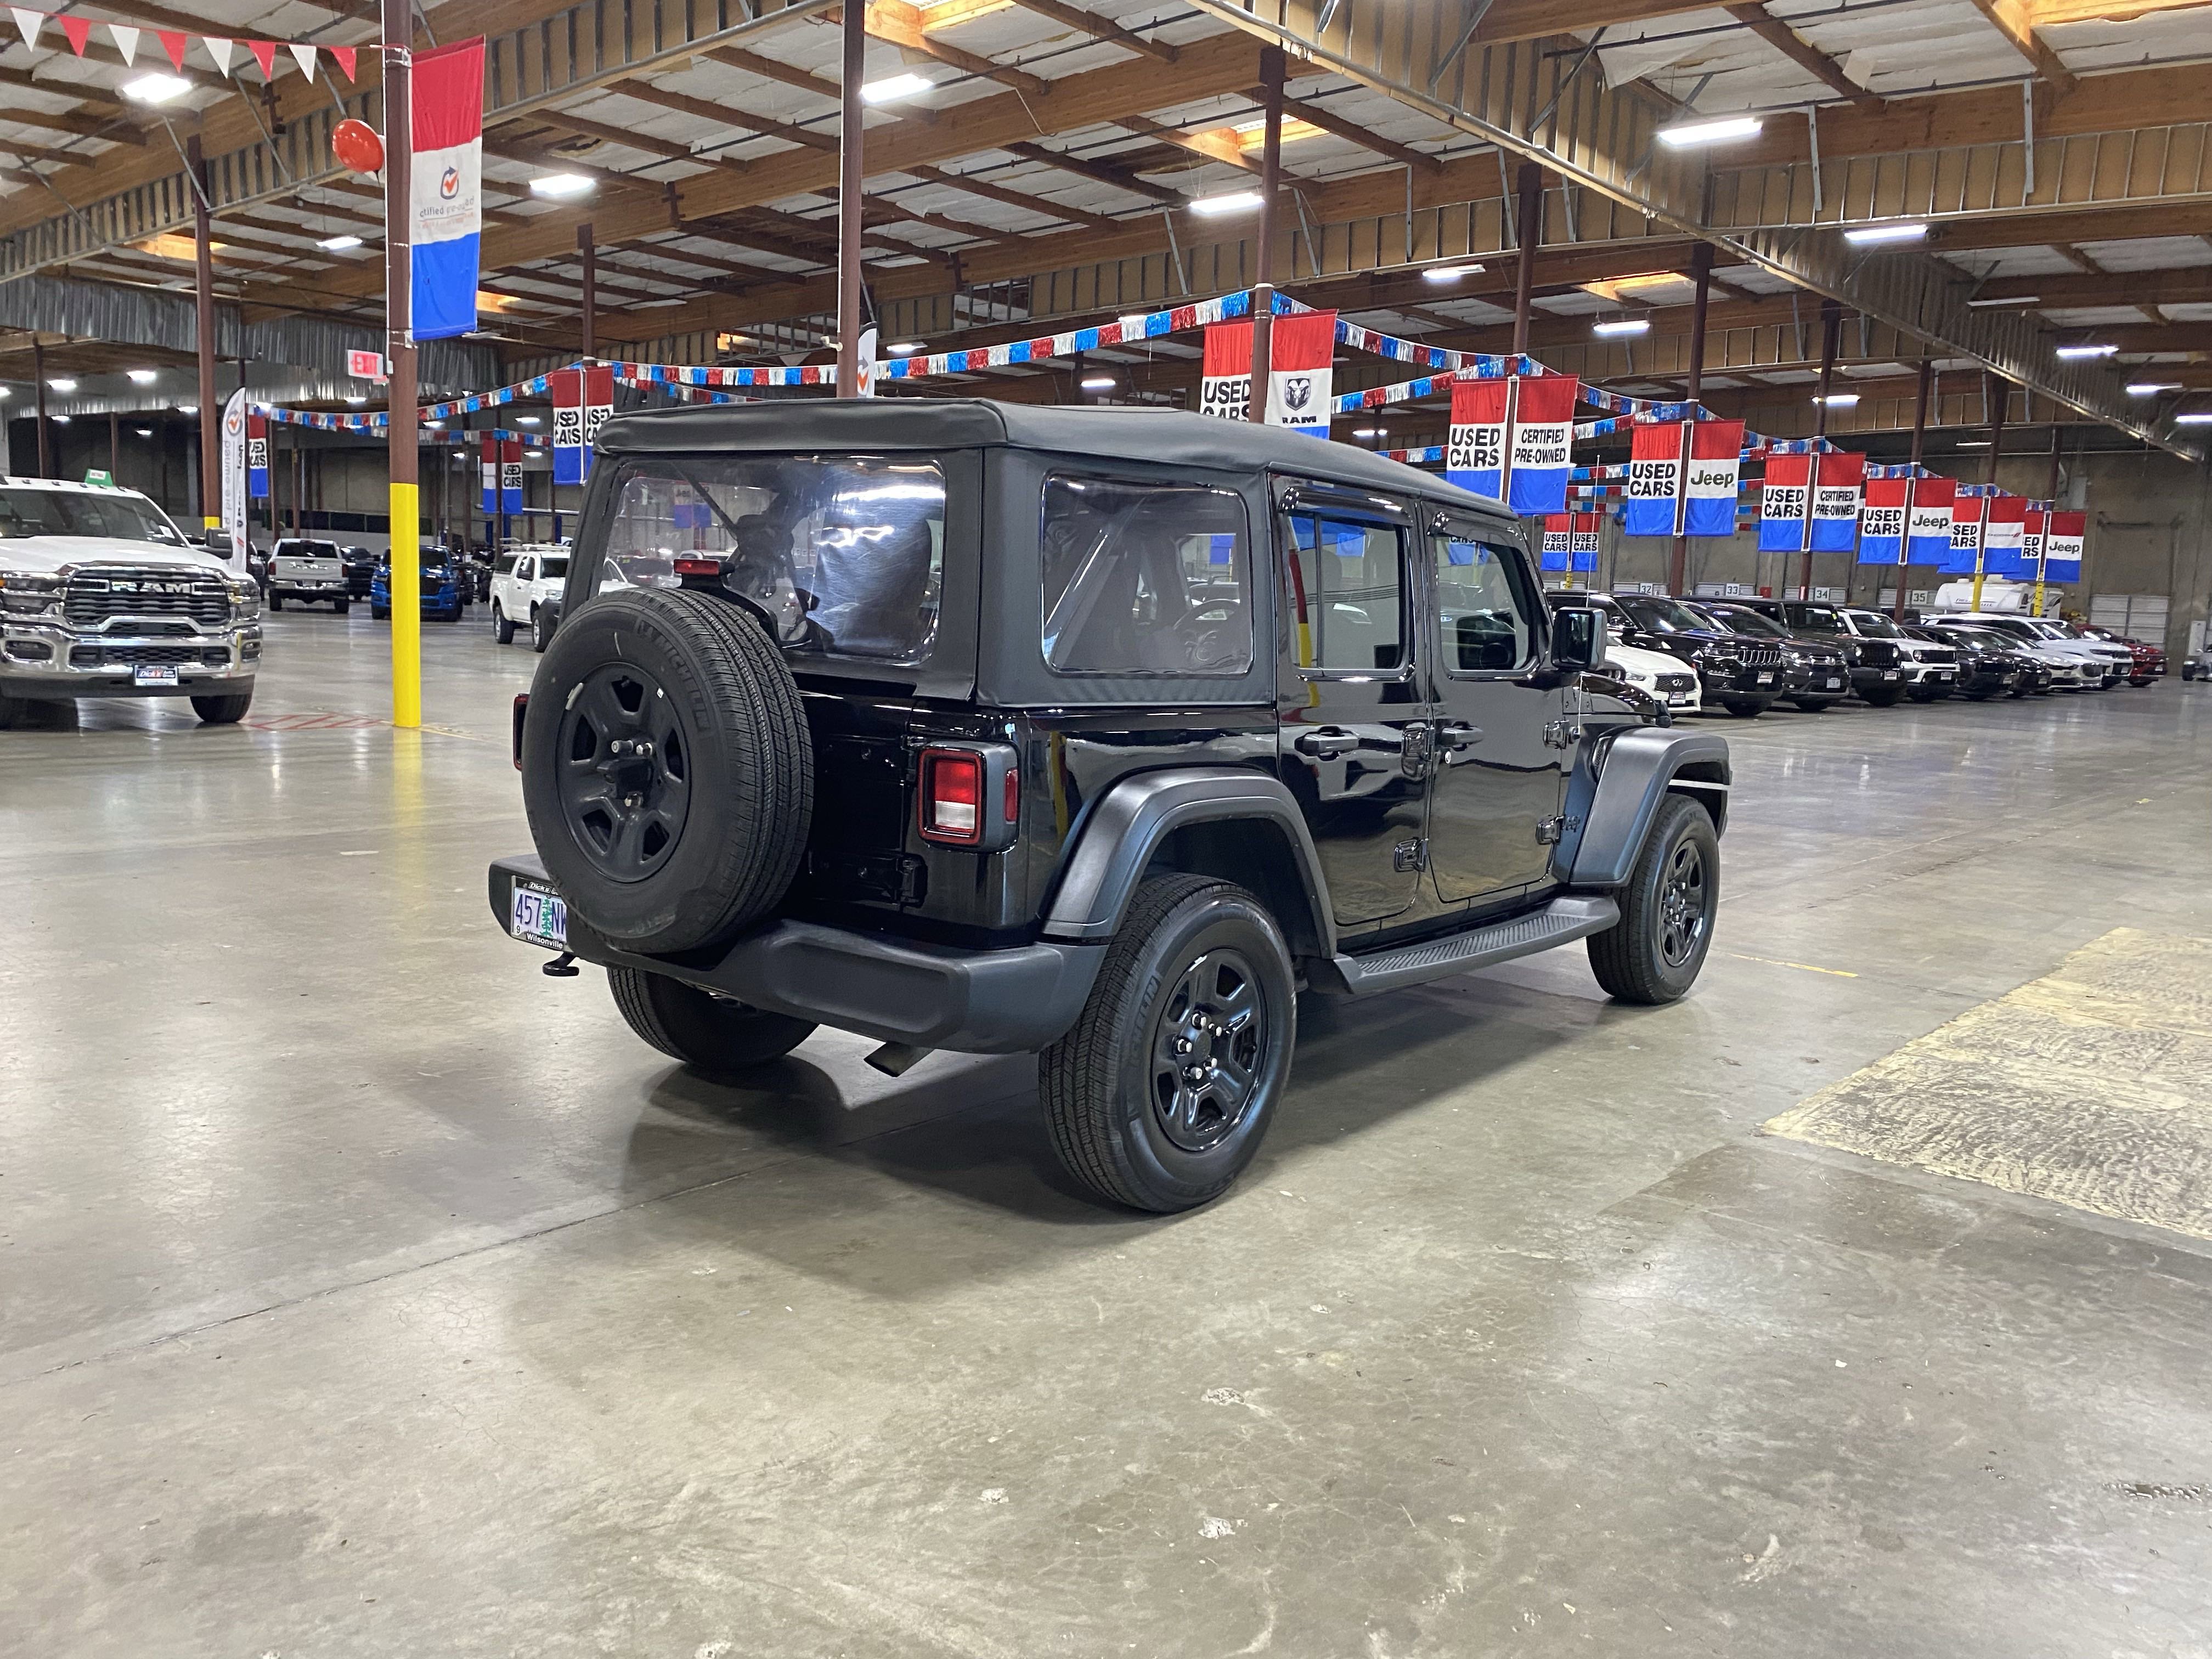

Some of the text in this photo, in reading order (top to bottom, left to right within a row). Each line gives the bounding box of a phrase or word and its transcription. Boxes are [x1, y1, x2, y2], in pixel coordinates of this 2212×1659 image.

[1204, 379, 1251, 404] USED
[1451, 428, 1500, 447] USED
[1521, 428, 1565, 444] CERTIFIED
[1450, 448, 1499, 467] CARS
[1514, 448, 1566, 464] PRE-OWNED
[1632, 463, 1676, 479] USED
[1690, 470, 1734, 488] Jeep
[1630, 481, 1674, 496] CARS
[1765, 488, 1804, 503] USED
[1820, 490, 1854, 501] CERTIFIED
[1764, 503, 1803, 517] CARS
[1815, 504, 1855, 516] PRE-OWNED
[1866, 509, 1902, 521] USED
[1912, 515, 1949, 529] Jeep
[1864, 523, 1900, 535] CARS
[1953, 524, 1977, 535] SED
[1545, 534, 1567, 542] USED
[1575, 534, 1598, 542] USED
[1951, 536, 1977, 548] ARS
[2024, 537, 2040, 546] ED
[1544, 543, 1567, 551] CARS
[1574, 543, 1597, 551] CARS
[2023, 549, 2039, 557] RS
[2049, 541, 2080, 554] Jeep
[111, 581, 190, 593] RAM
[1641, 585, 1652, 594] 32
[1727, 586, 1738, 594] 33
[1816, 590, 1827, 599] 34
[1914, 593, 1926, 602] 35
[652, 634, 711, 731] MICHELIN
[515, 894, 541, 928] 457
[516, 925, 521, 933] 9
[527, 933, 563, 949] Wilsonville
